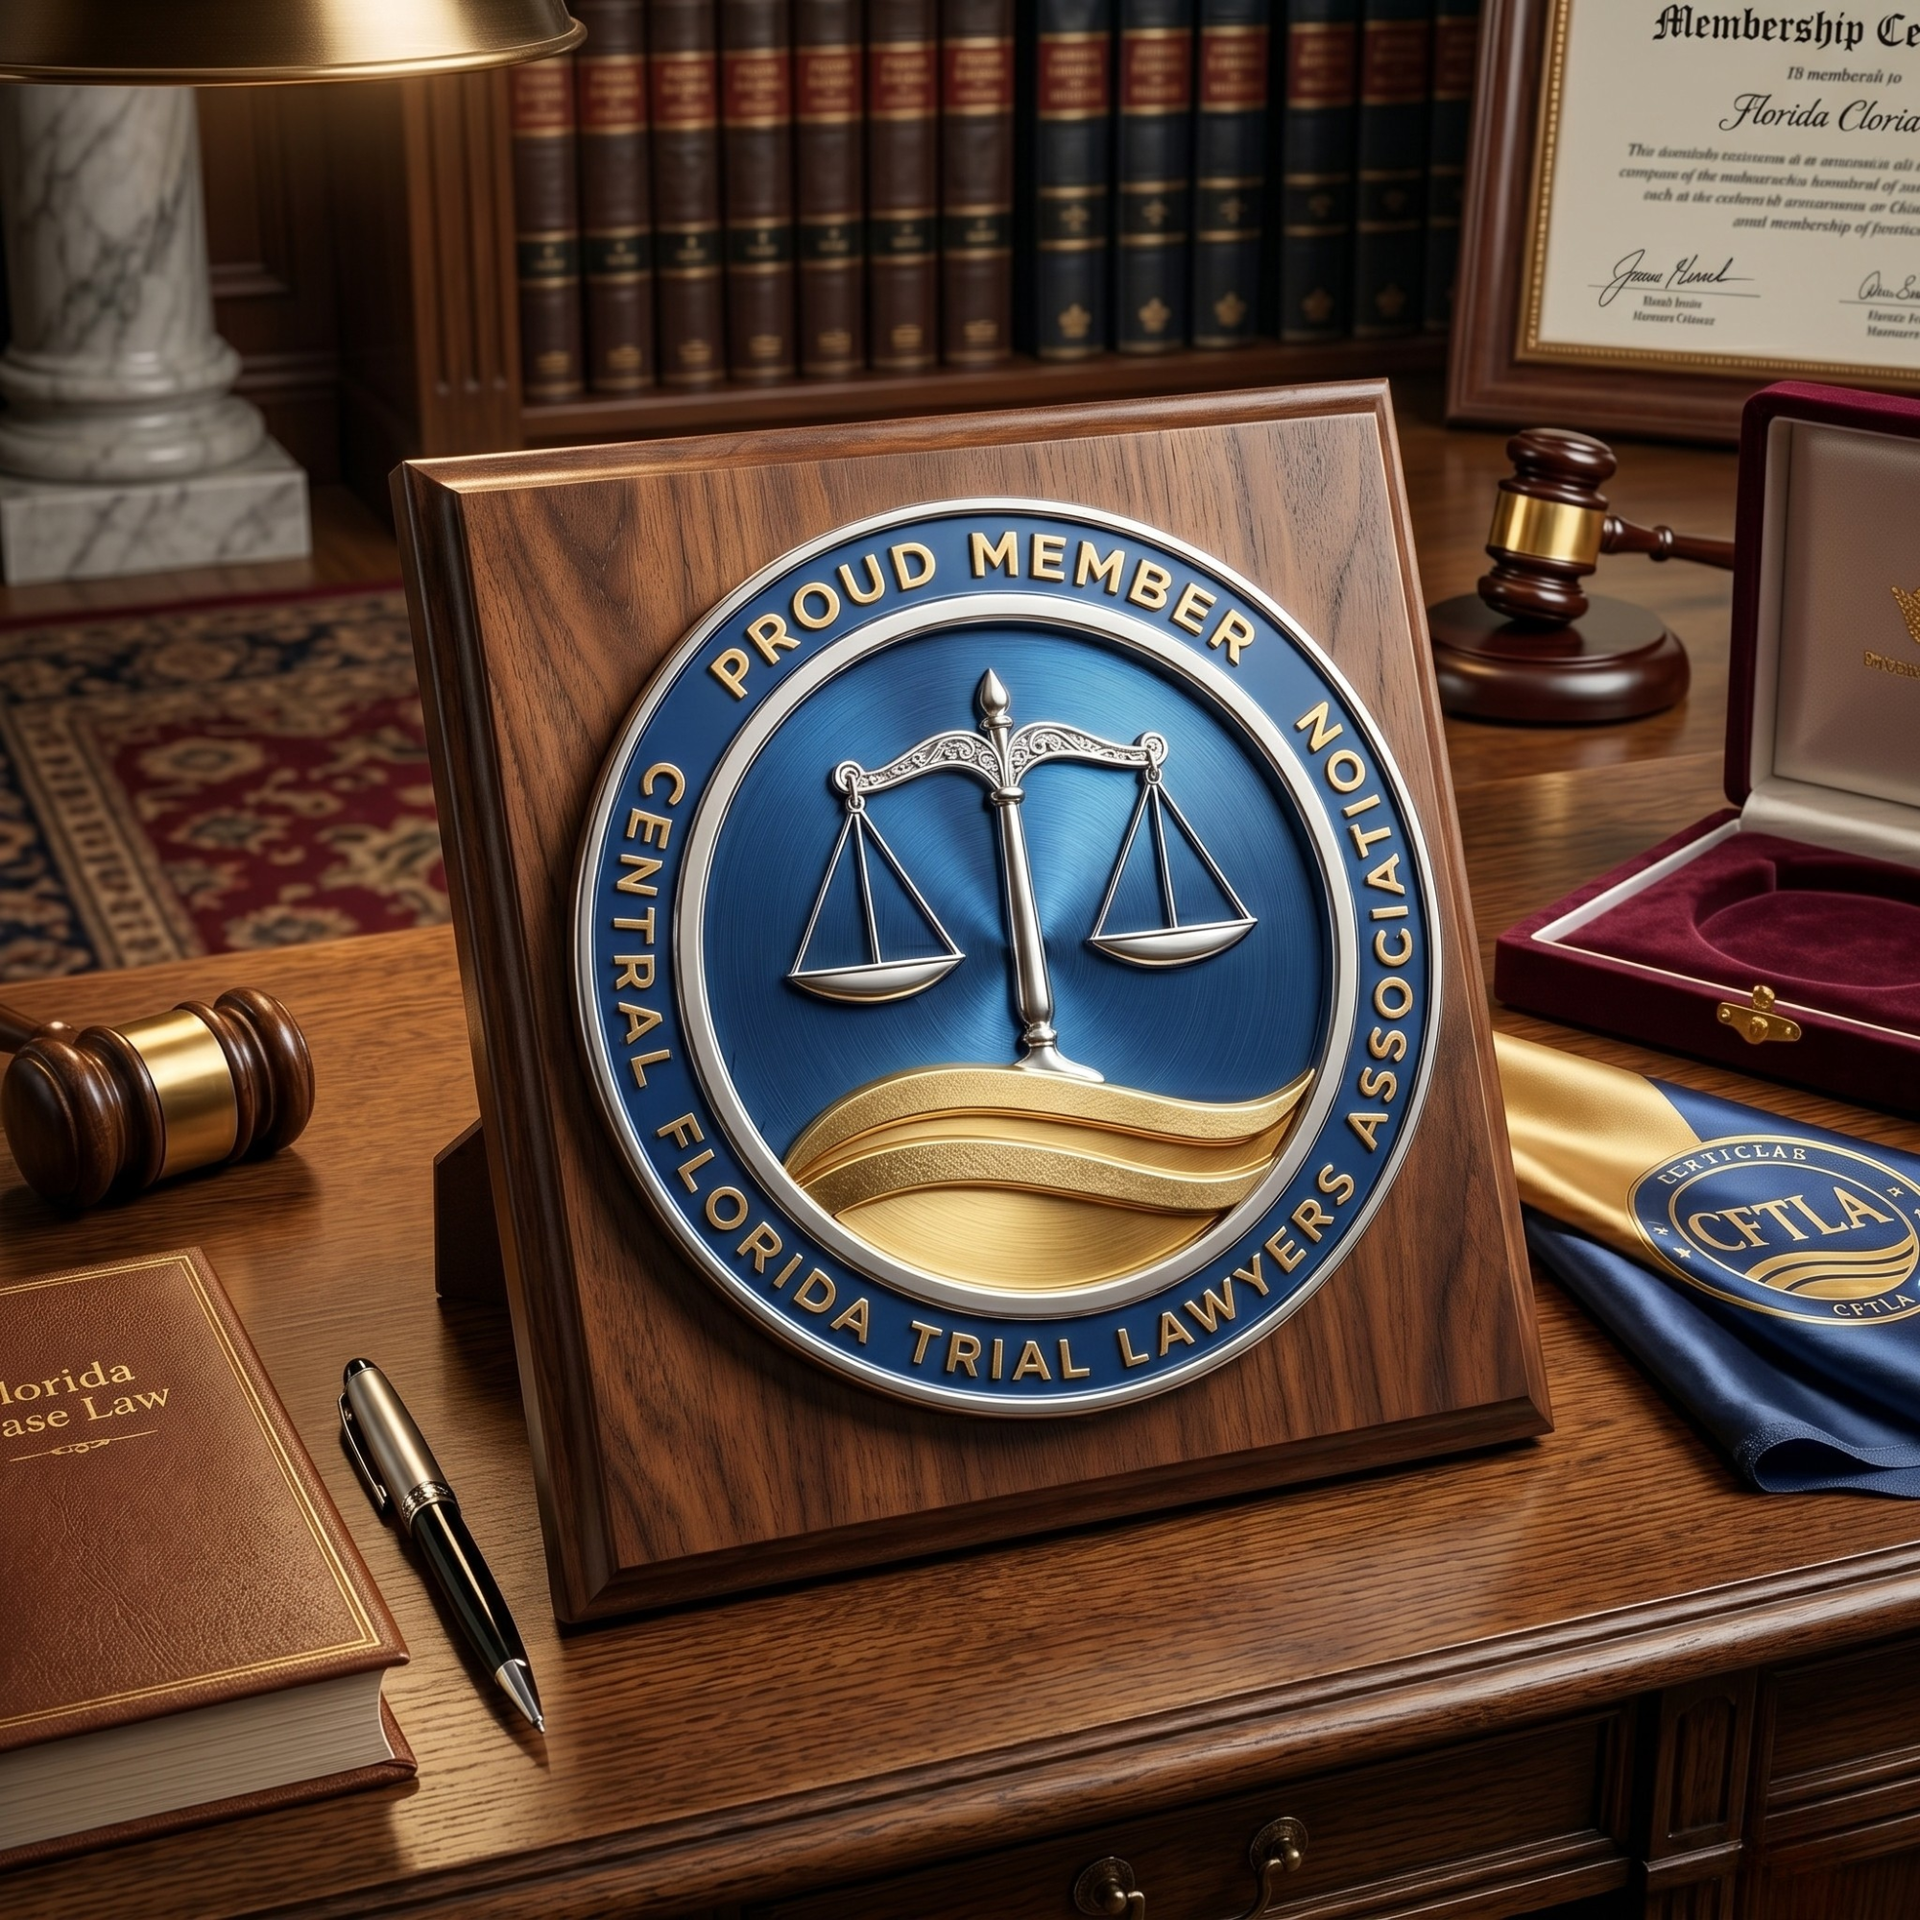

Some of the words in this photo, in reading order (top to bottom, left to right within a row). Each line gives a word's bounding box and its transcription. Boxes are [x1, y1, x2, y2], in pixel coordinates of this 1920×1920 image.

[1652, 4, 1864, 52] Membership
[1718, 93, 1830, 131] Florida
[708, 541, 937, 700] PROUD
[969, 530, 1256, 666] MEMBER
[613, 762, 686, 1089] CENTRAL
[656, 1111, 872, 1345] FLORIDA
[910, 1320, 1090, 1381] TRIAL
[1115, 1163, 1356, 1368] LAWYERS
[1295, 701, 1413, 1153] ASSOCIATION
[1687, 1186, 1895, 1252] CFTLA
[2, 1409, 71, 1438] ase
[80, 1388, 170, 1421] Law
